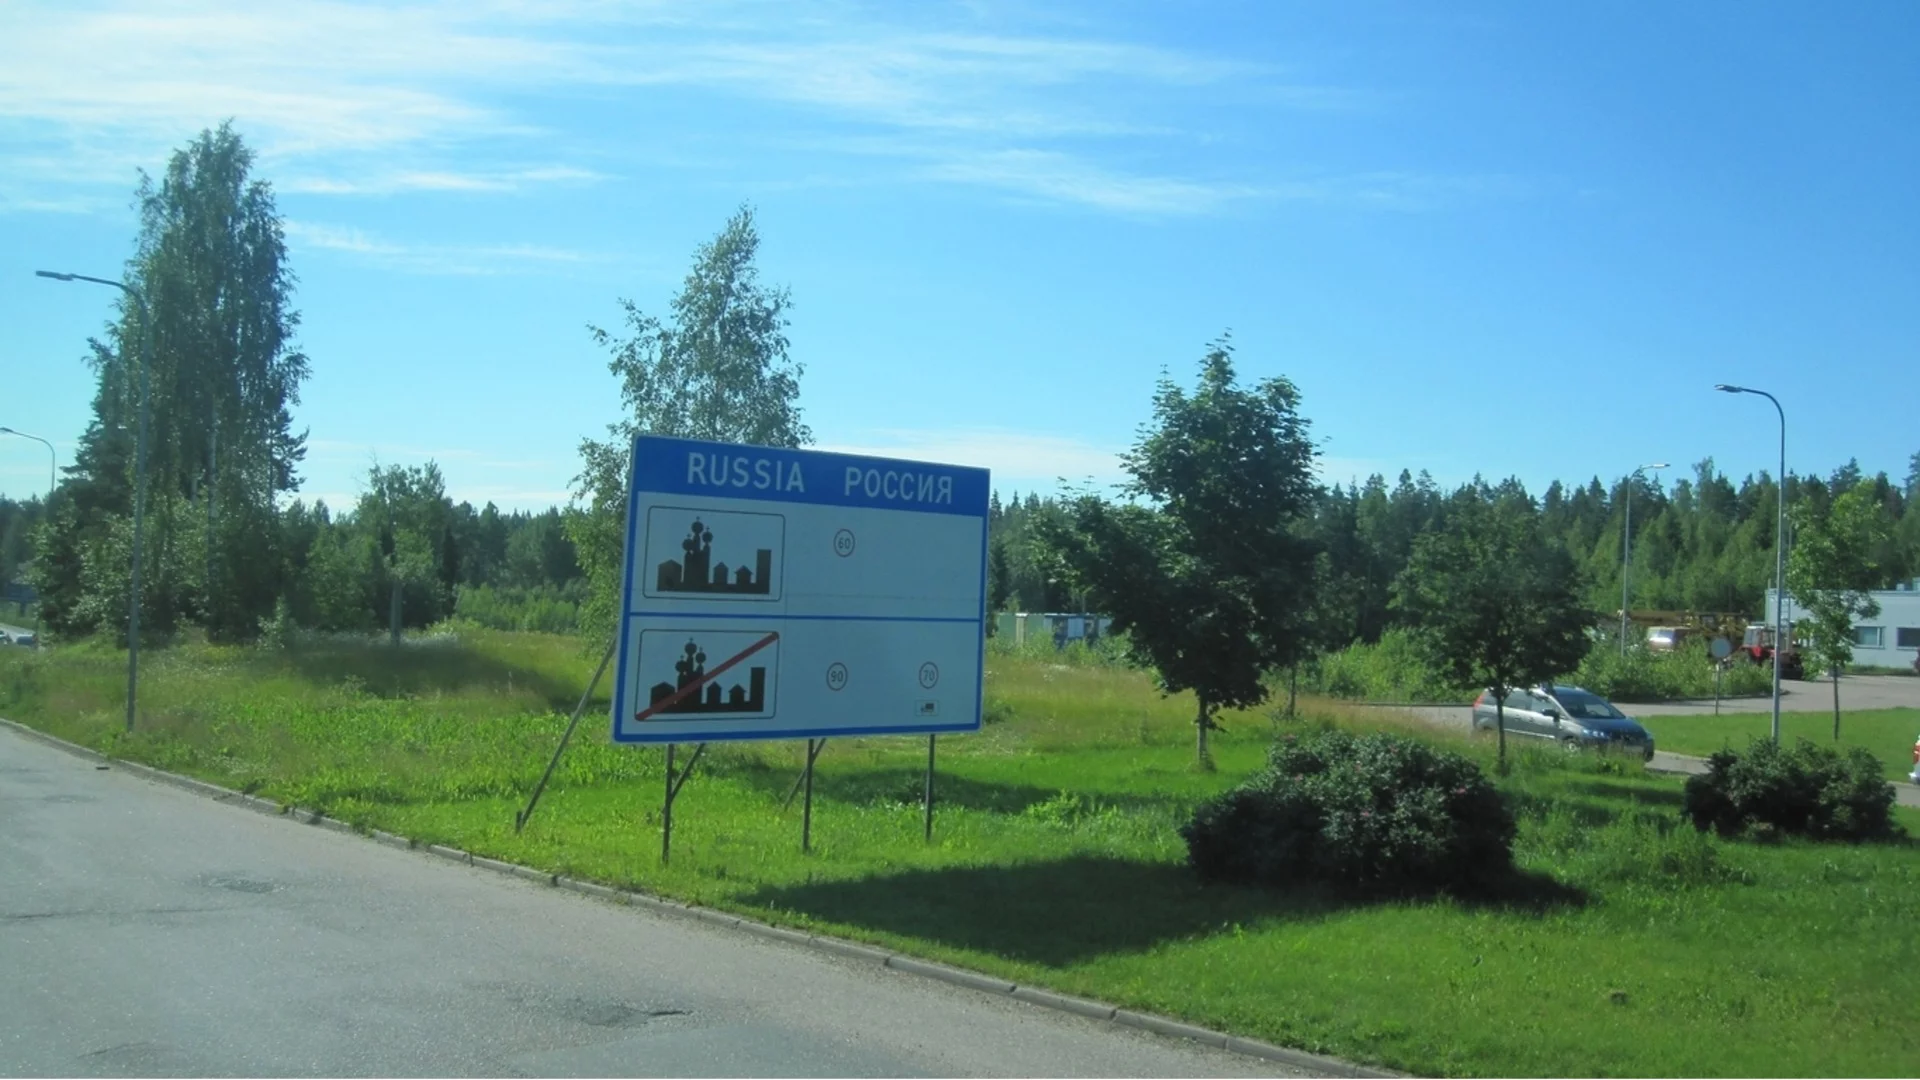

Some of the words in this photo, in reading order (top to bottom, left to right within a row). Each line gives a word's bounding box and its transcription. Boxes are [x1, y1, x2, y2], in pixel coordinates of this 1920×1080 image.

[687, 452, 805, 493] RUSSIA
[844, 466, 952, 504] РОССИЯ
[837, 537, 851, 550] 60
[830, 669, 844, 682] 90
[923, 669, 936, 682] 70
